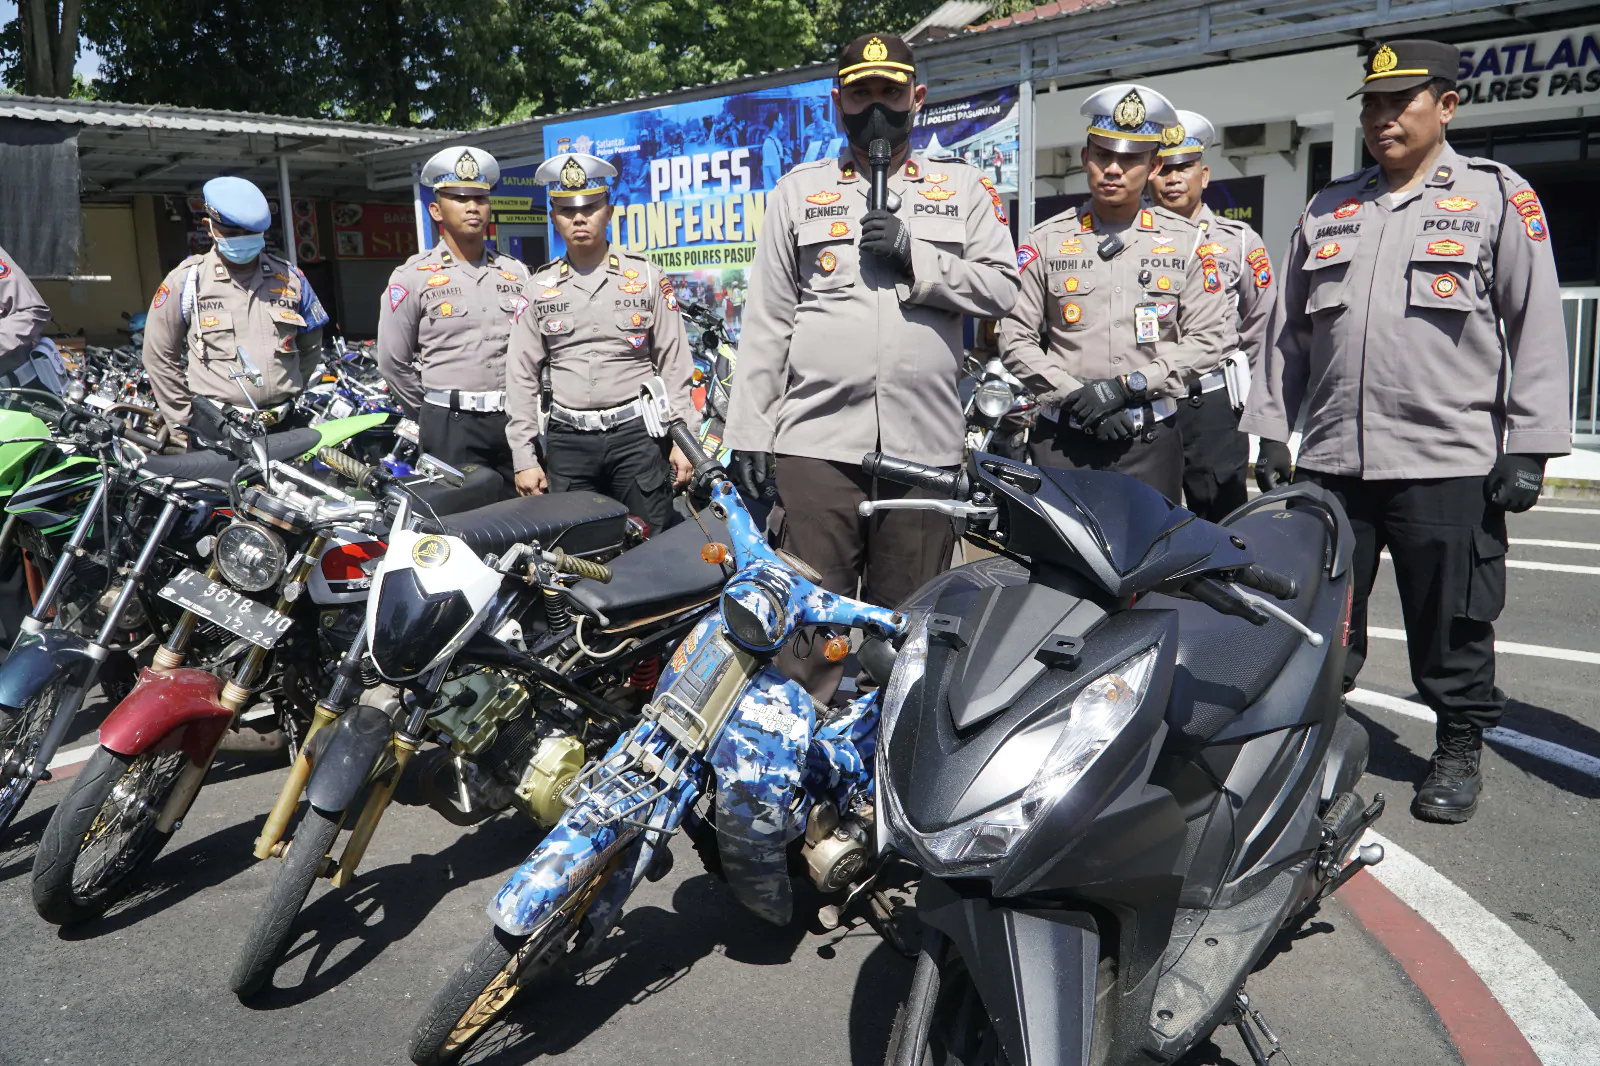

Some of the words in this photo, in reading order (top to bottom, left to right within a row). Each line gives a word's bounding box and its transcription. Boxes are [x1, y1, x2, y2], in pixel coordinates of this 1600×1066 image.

[1456, 76, 1540, 106] OLRES
[927, 112, 957, 125] POLRES
[958, 105, 1000, 120] PASURUAN
[928, 102, 971, 115] SATLANTAS
[651, 148, 750, 202] PRESS
[805, 205, 849, 220] KENNEDY
[913, 203, 959, 217] POLRI
[1224, 207, 1252, 219] SIM
[610, 191, 773, 253] CONFEREN
[1423, 219, 1481, 233] POLRI
[650, 251, 682, 267] ANTAS
[684, 249, 722, 266] POLRES
[1140, 258, 1185, 270] POLRI
[1050, 259, 1078, 272] YUDHI
[1081, 259, 1094, 270] AP
[537, 302, 571, 316] YUSUF
[615, 298, 651, 309] POLRI
[174, 568, 195, 584] W
[203, 582, 254, 613] 5678
